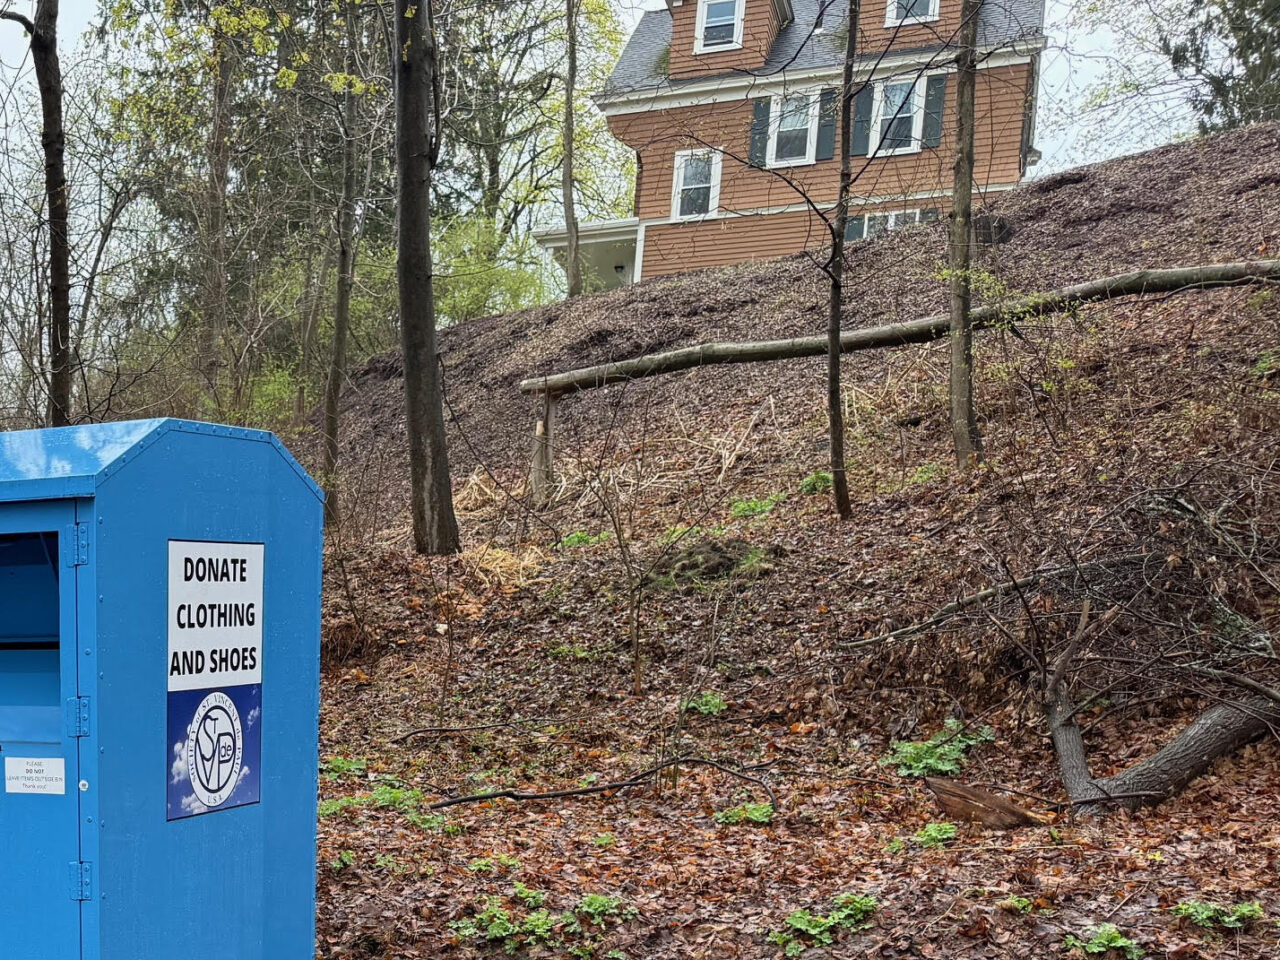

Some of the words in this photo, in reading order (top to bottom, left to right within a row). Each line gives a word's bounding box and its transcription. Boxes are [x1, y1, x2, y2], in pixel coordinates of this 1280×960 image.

[184, 557, 247, 582] DONATE
[177, 603, 255, 629] CLOTHING
[170, 650, 205, 676] AND
[209, 646, 257, 673] SHOES
[213, 693, 238, 722] VINCENT
